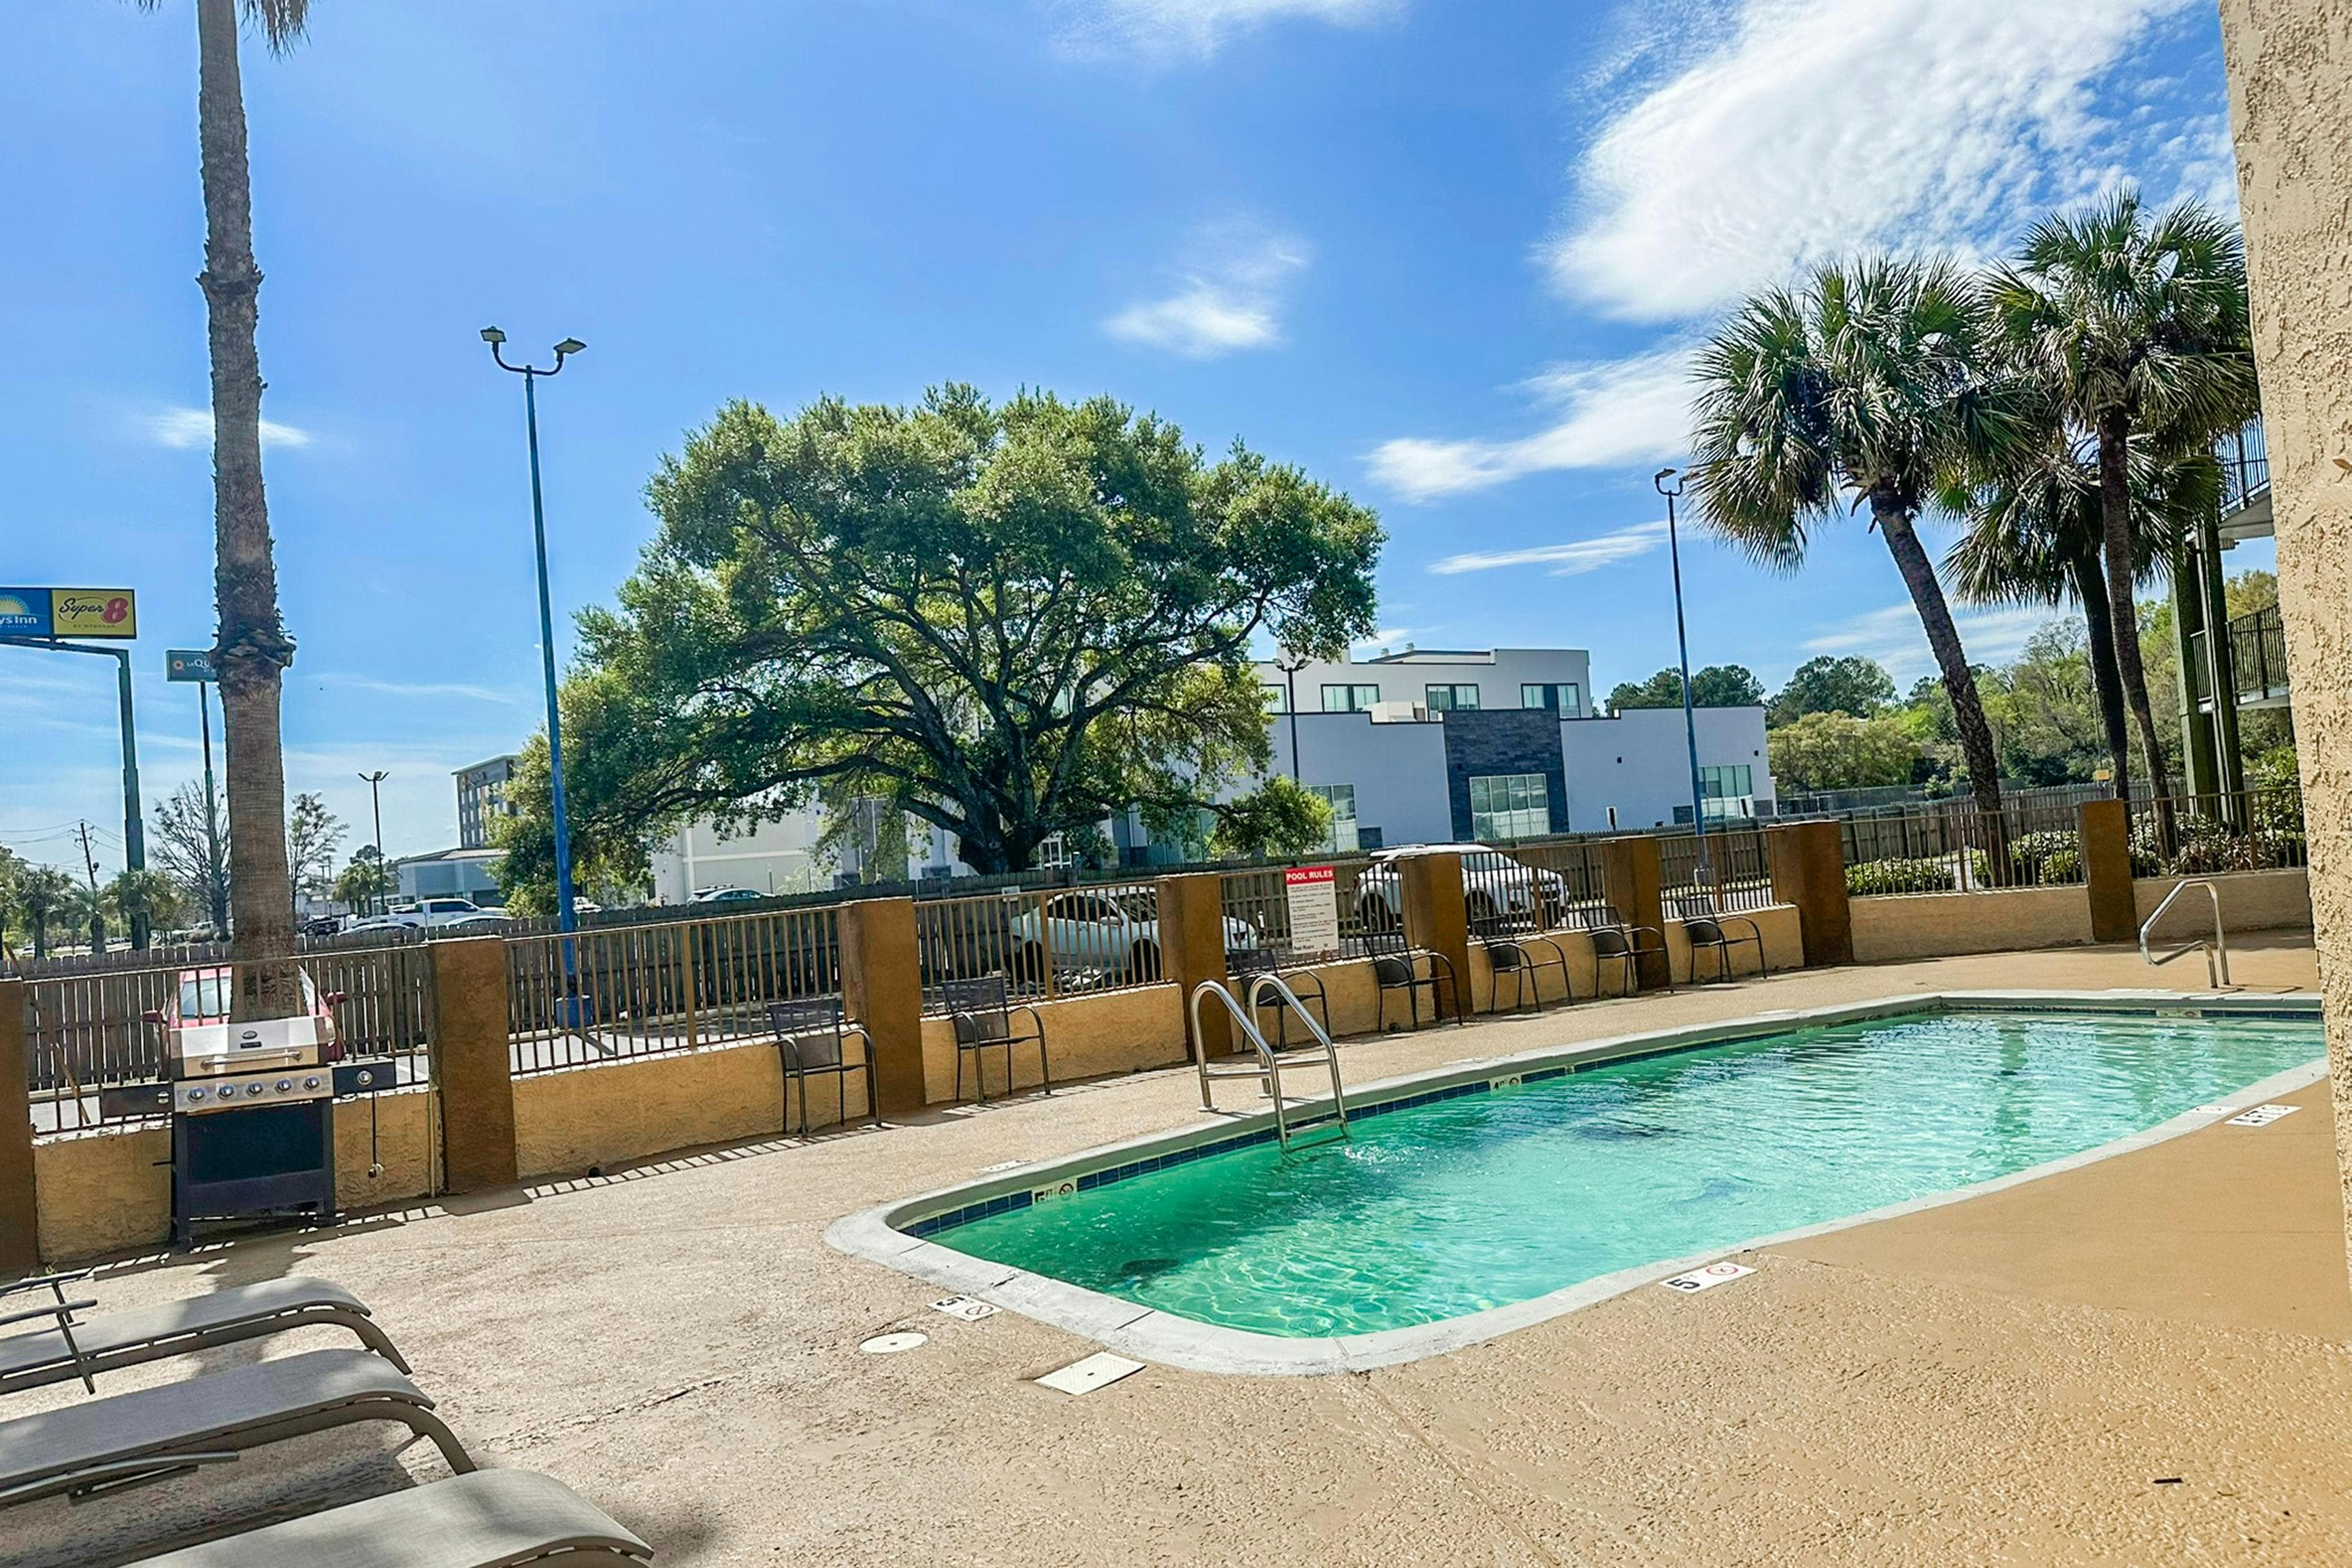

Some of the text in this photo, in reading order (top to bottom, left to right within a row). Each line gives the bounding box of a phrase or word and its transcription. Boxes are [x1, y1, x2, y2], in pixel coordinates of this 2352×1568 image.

[59, 597, 129, 624] Super 8
[1286, 870, 1333, 881] POOL RULES
[1667, 1278, 1701, 1290] 5
